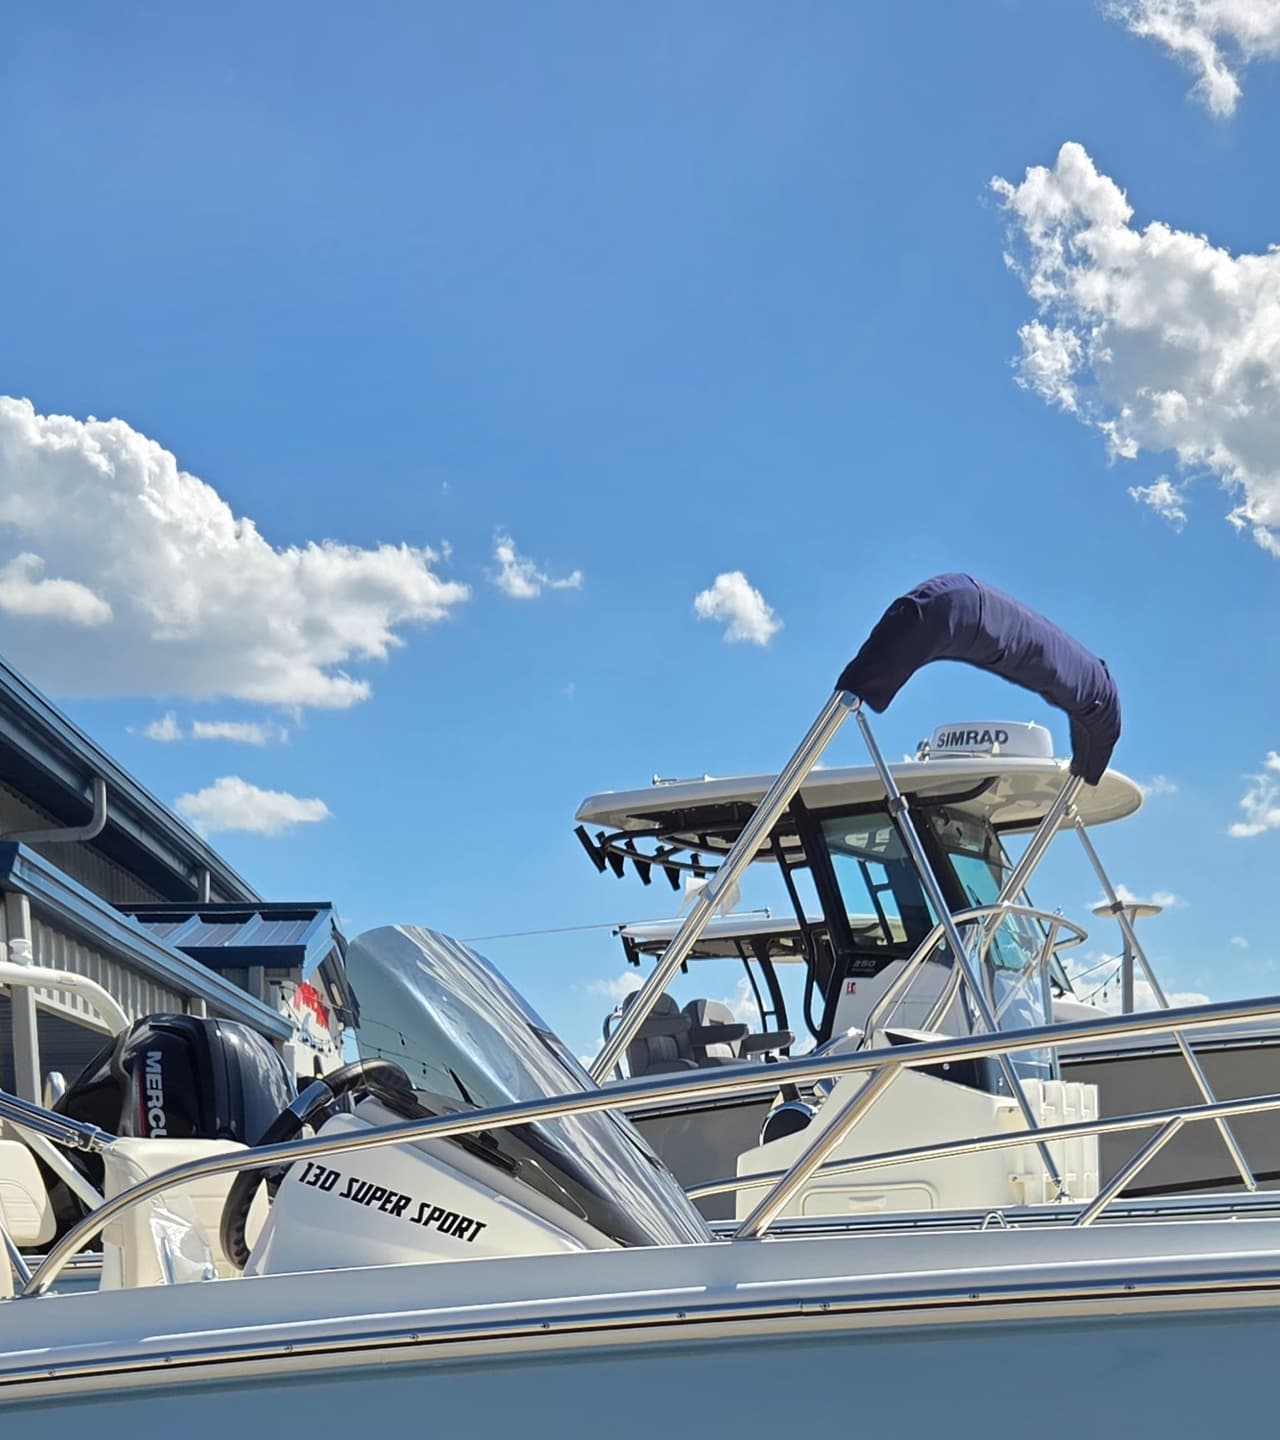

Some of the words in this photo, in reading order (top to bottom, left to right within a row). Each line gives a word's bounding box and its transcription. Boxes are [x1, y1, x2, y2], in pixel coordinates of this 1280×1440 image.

[937, 729, 1009, 749] SIMRAD
[298, 1161, 342, 1193] 130
[339, 1177, 413, 1218] SUPER
[410, 1202, 488, 1243] SPORT
